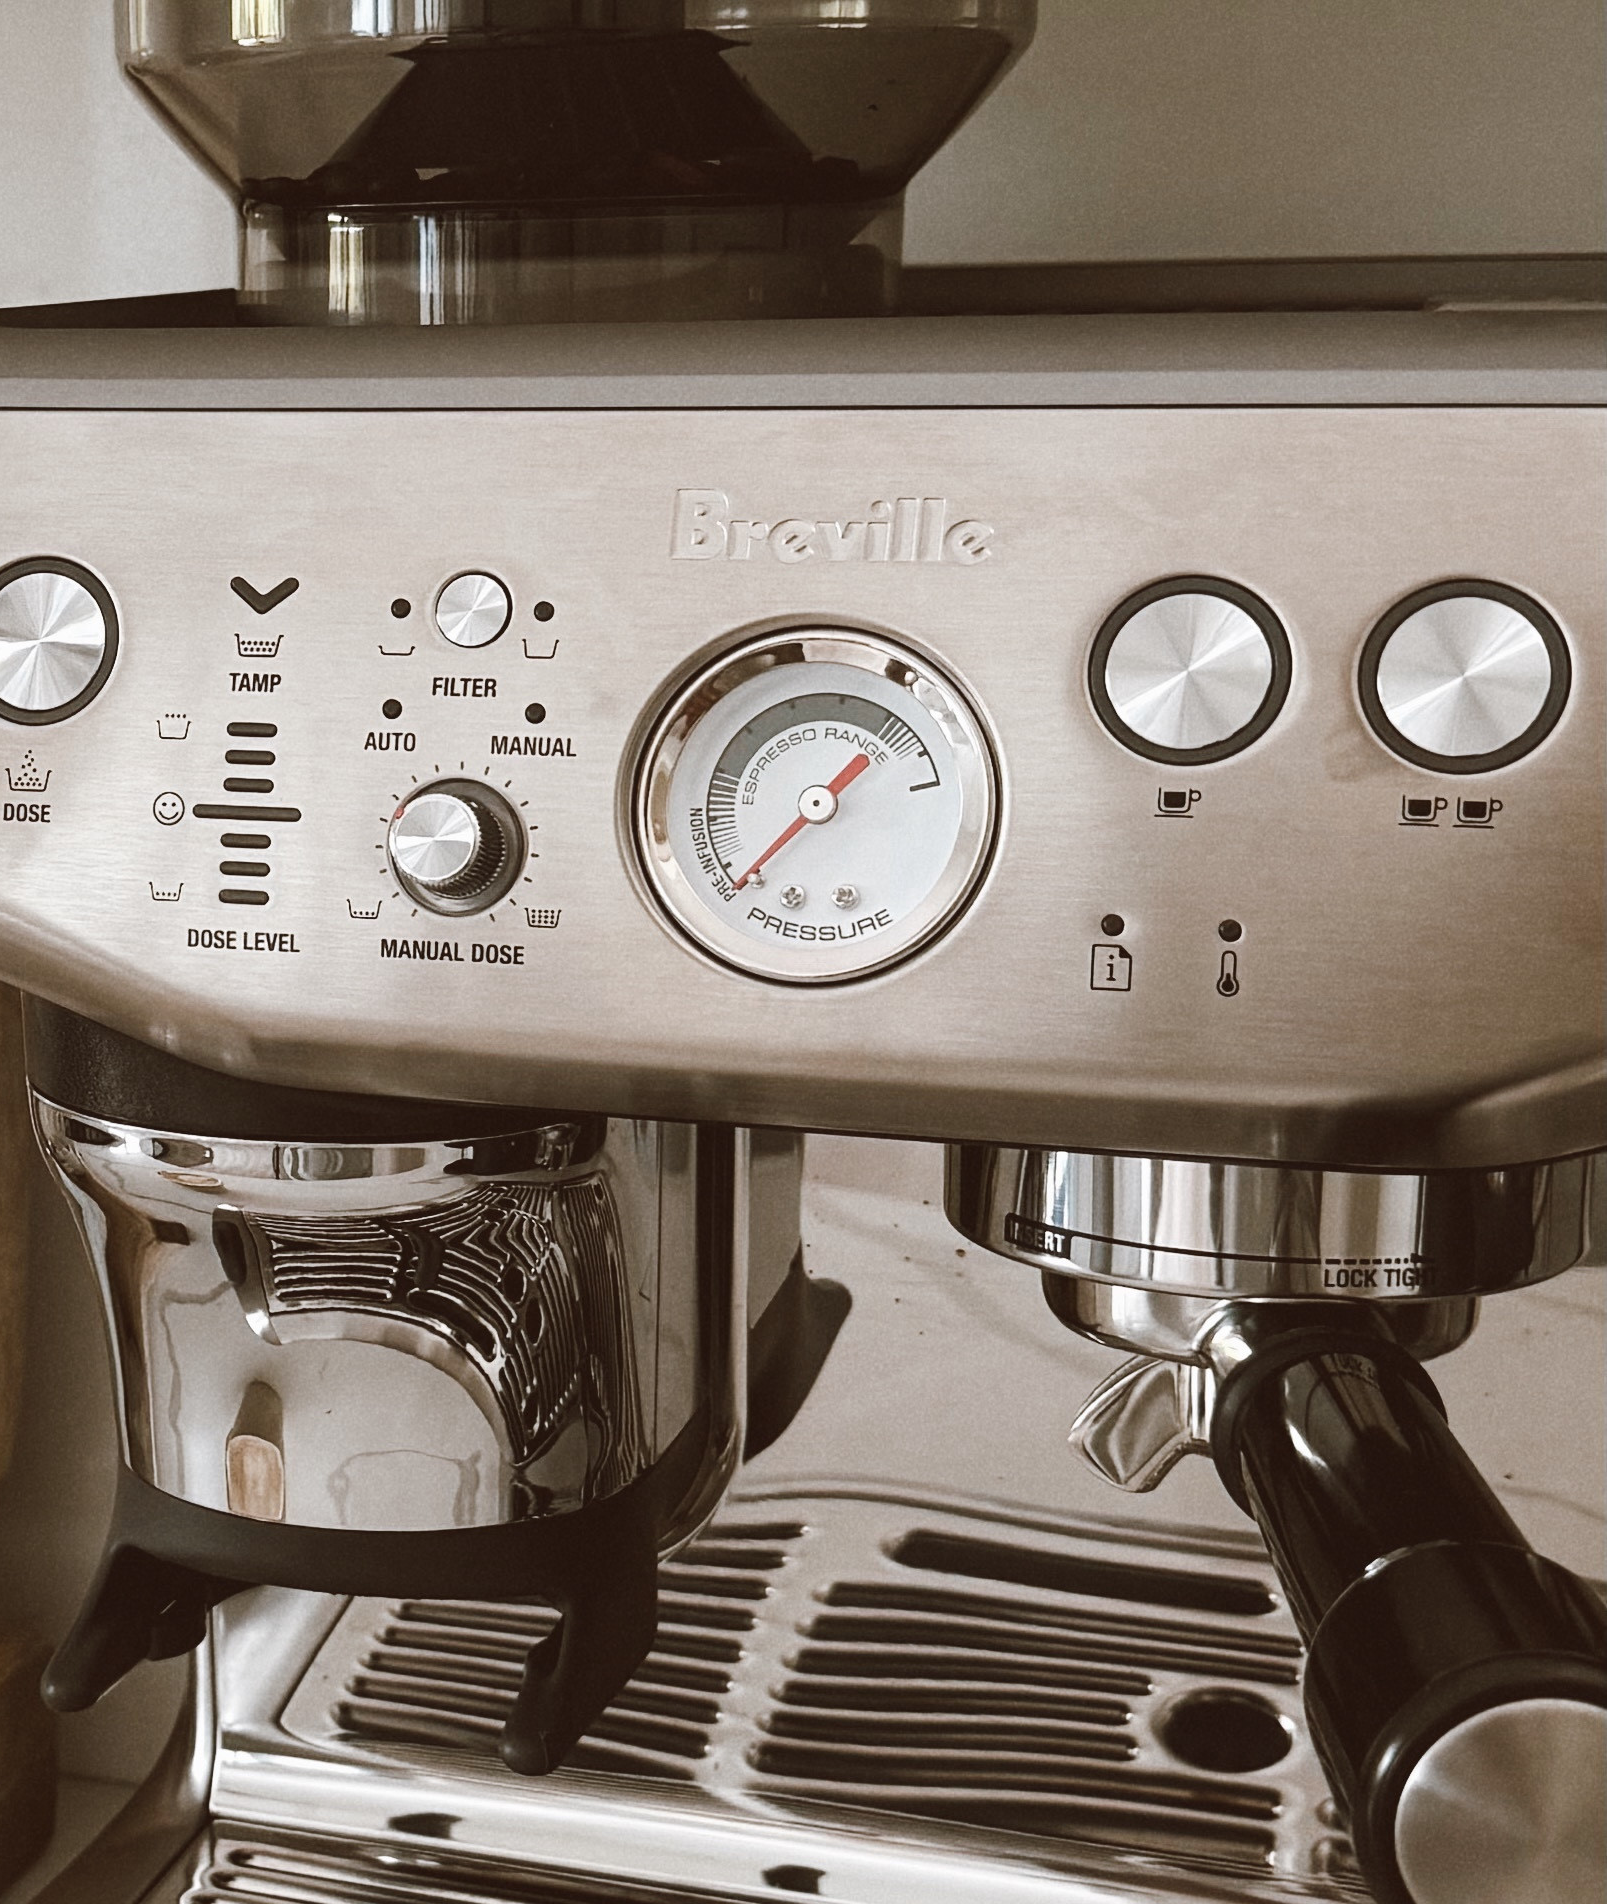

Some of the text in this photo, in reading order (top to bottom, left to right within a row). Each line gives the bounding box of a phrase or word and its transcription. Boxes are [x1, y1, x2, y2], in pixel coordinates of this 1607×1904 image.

[670, 488, 994, 564] Breville
[229, 673, 282, 693] TAMP
[432, 677, 497, 698] FILTER
[364, 732, 417, 752] AUTO
[490, 735, 577, 757] MANUAL
[742, 727, 889, 805] ESPRESSO RANGE
[2, 802, 51, 823] DOSE
[689, 807, 737, 902] PRE-INFUSION
[747, 908, 893, 941] PRESSURE
[187, 928, 300, 953] DOSE LEVEL
[380, 938, 525, 965] MANUAL DOSE
[1324, 1269, 1377, 1288] LOCK
